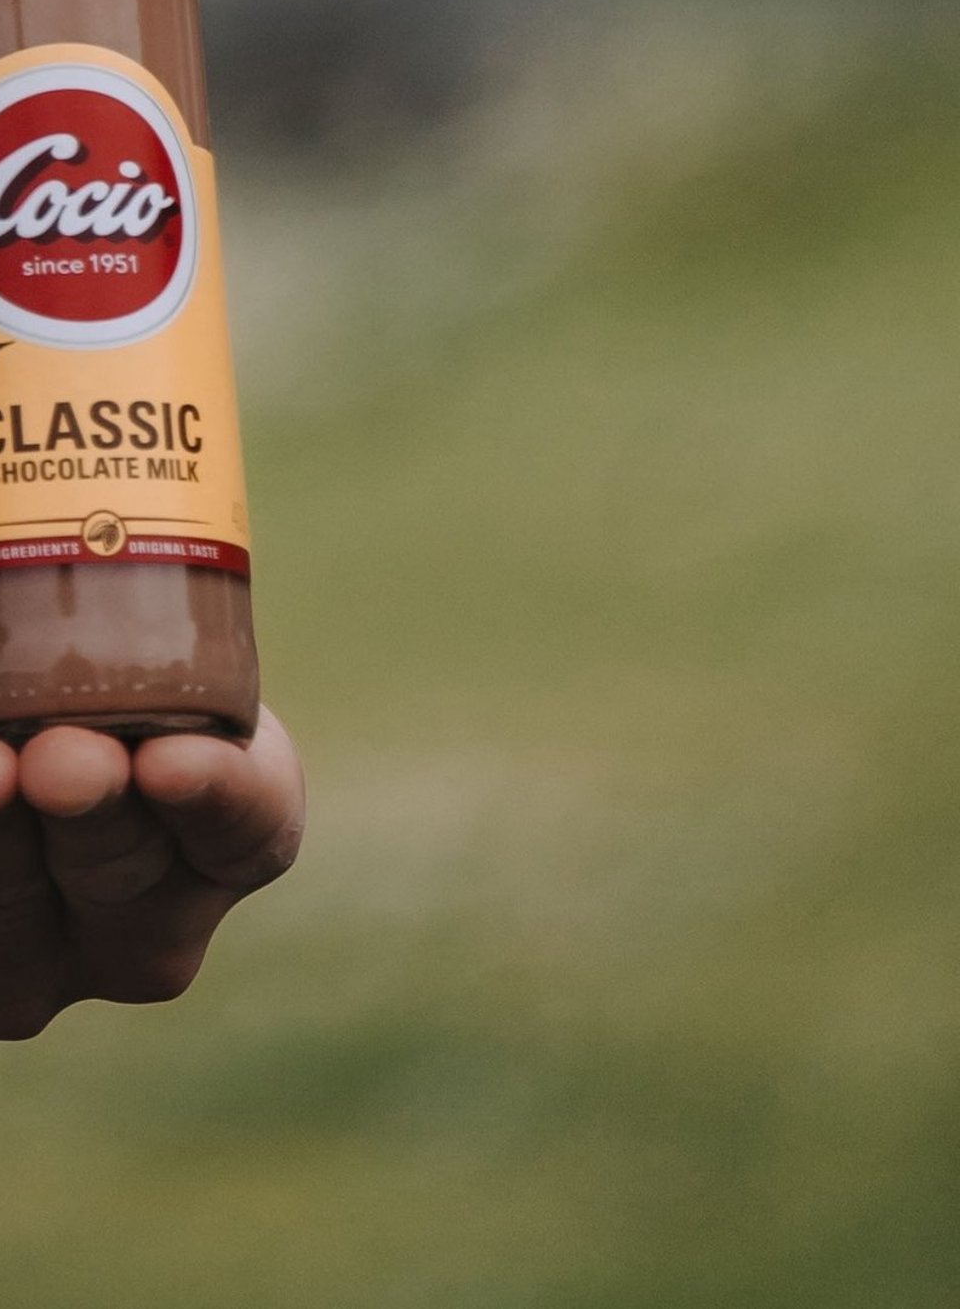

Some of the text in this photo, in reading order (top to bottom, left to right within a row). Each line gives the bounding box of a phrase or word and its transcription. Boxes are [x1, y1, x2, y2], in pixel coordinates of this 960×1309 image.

[22, 254, 139, 276] since 1951
[147, 457, 200, 484] MILK
[128, 541, 219, 560] ORIGINAL TASTE
